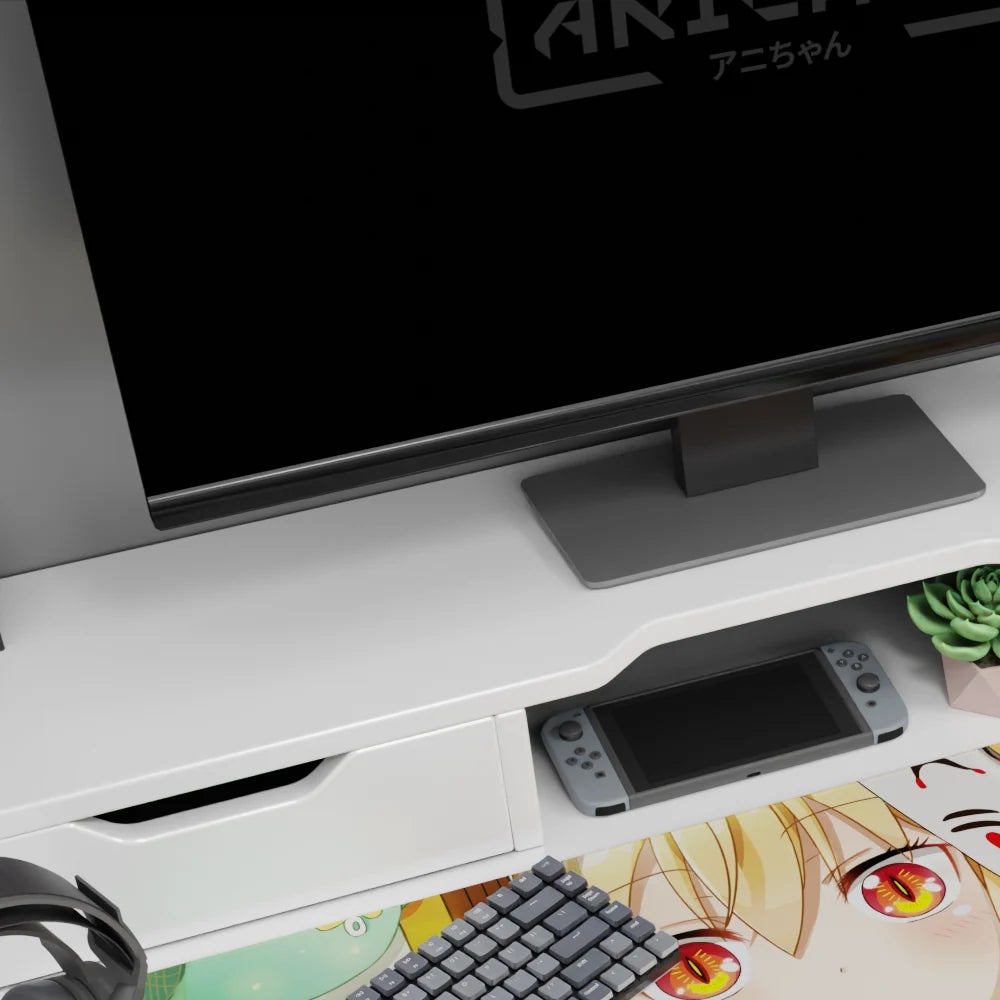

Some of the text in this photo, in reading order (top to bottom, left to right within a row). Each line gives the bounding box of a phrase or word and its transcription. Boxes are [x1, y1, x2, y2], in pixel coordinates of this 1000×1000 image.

[709, 31, 851, 80] アニちゃん
